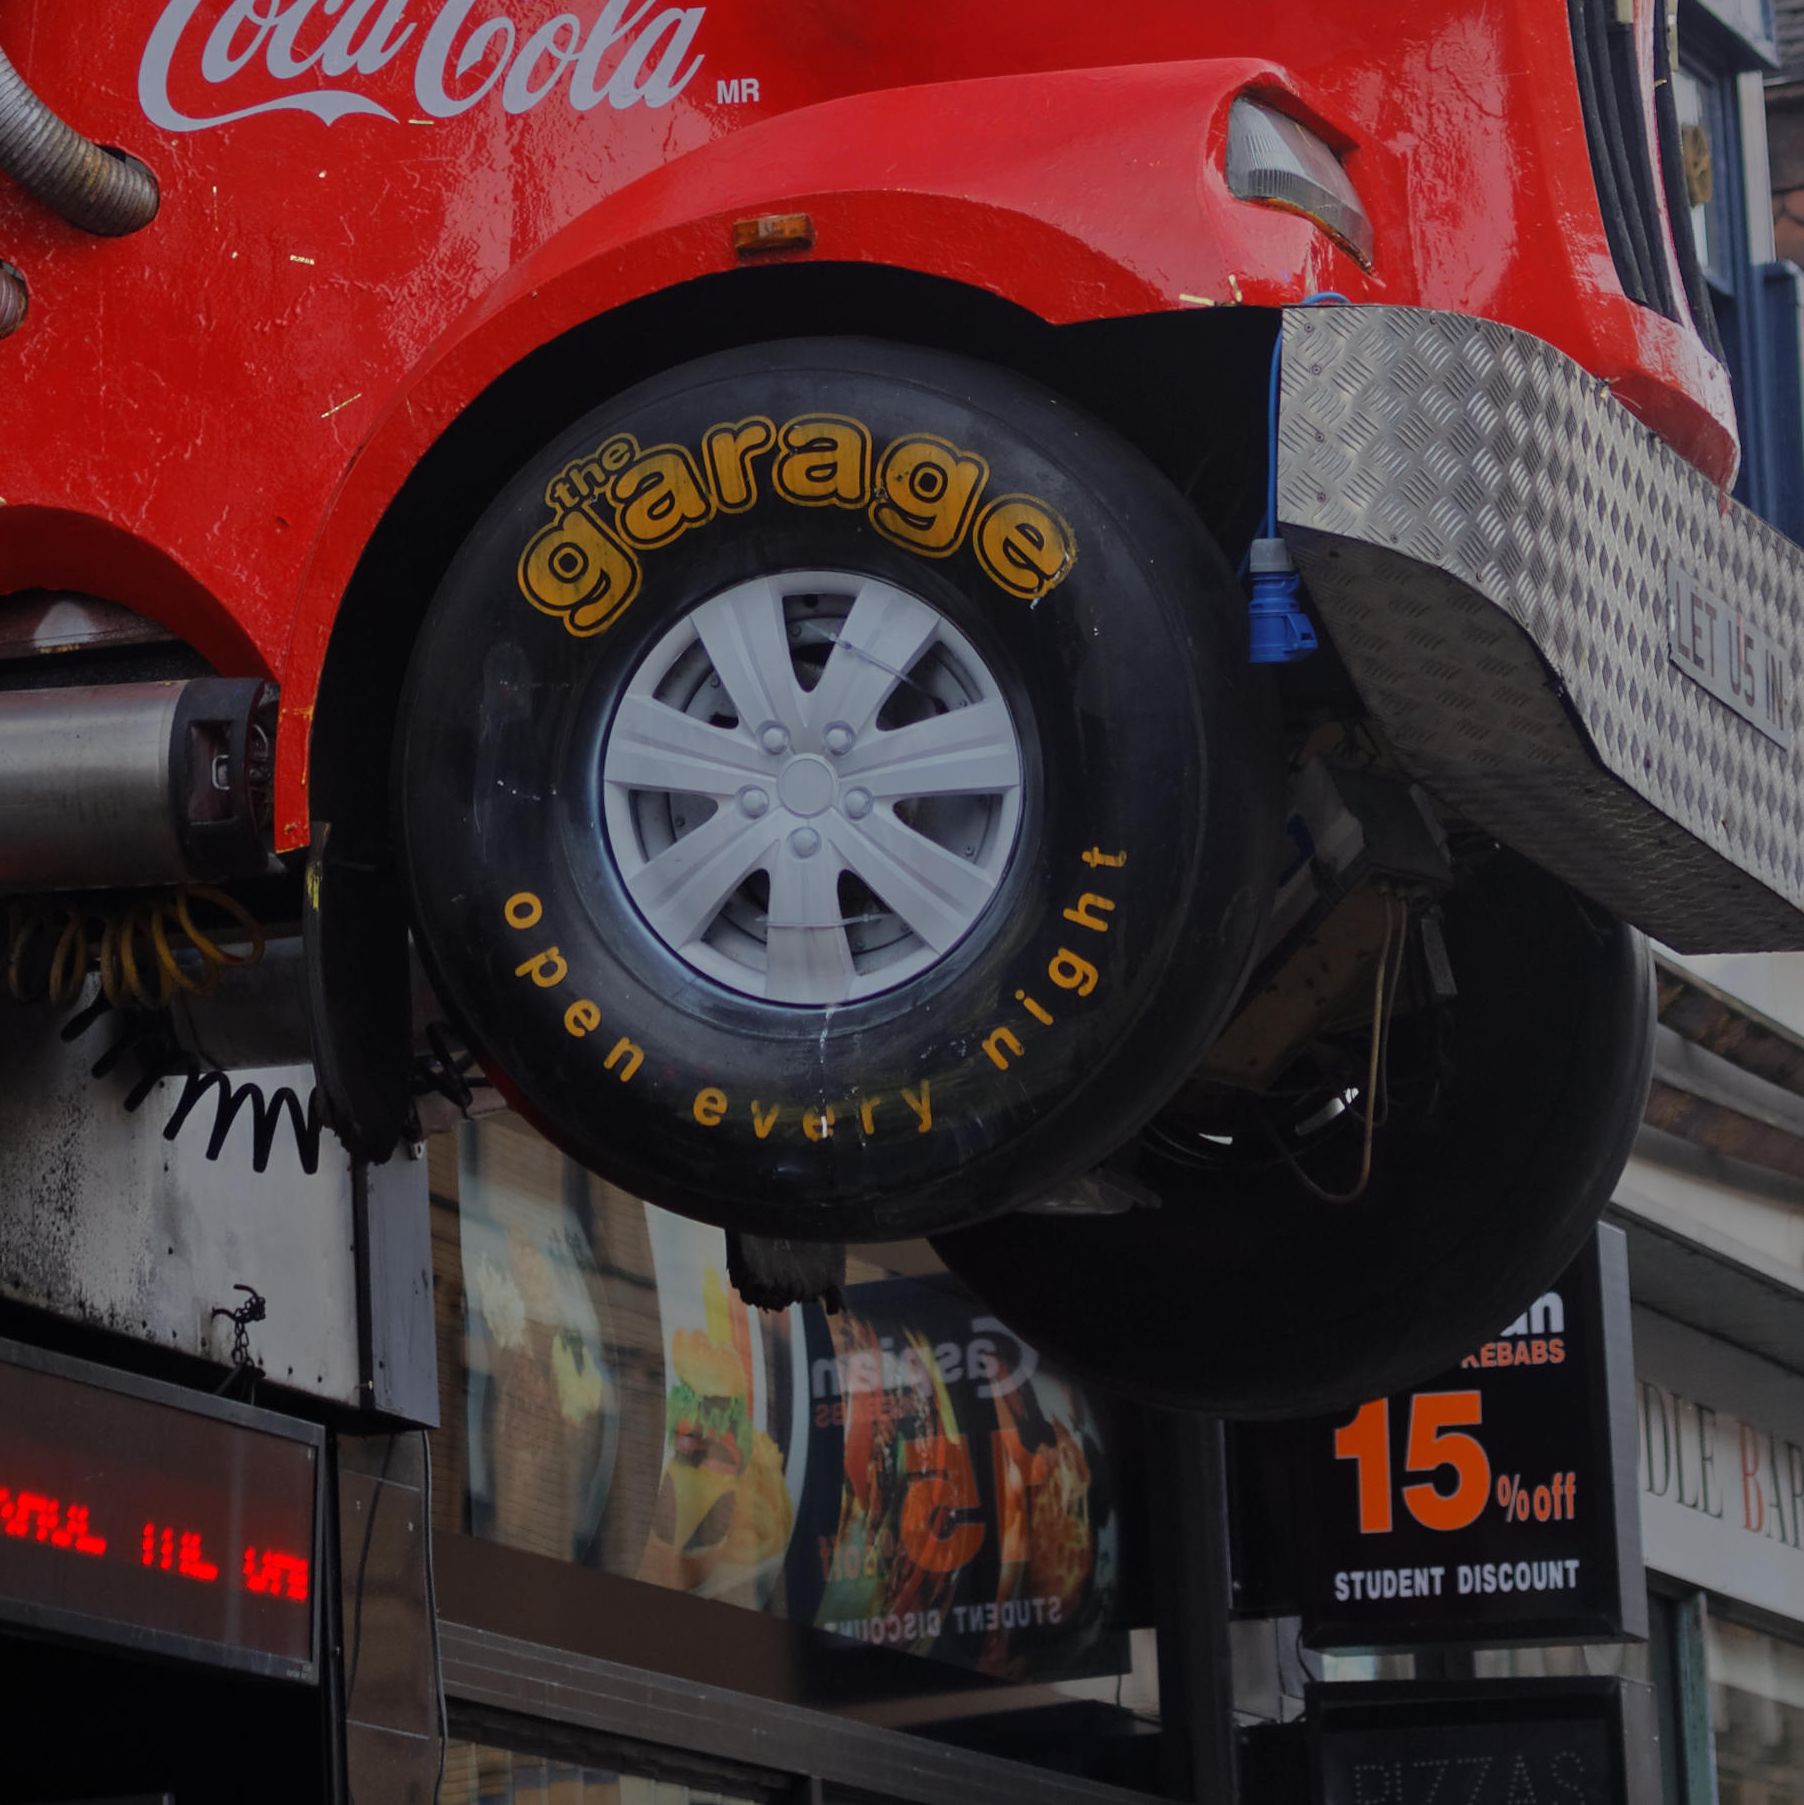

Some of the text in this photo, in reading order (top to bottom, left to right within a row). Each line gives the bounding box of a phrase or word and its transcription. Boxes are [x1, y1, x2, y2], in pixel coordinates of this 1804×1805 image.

[715, 77, 761, 105] MR
[518, 413, 1079, 637] the garage
[1676, 580, 1718, 678] LET
[504, 845, 1128, 1141] open every night
[1335, 1559, 1580, 1601] STUDENT DISCOUNT
